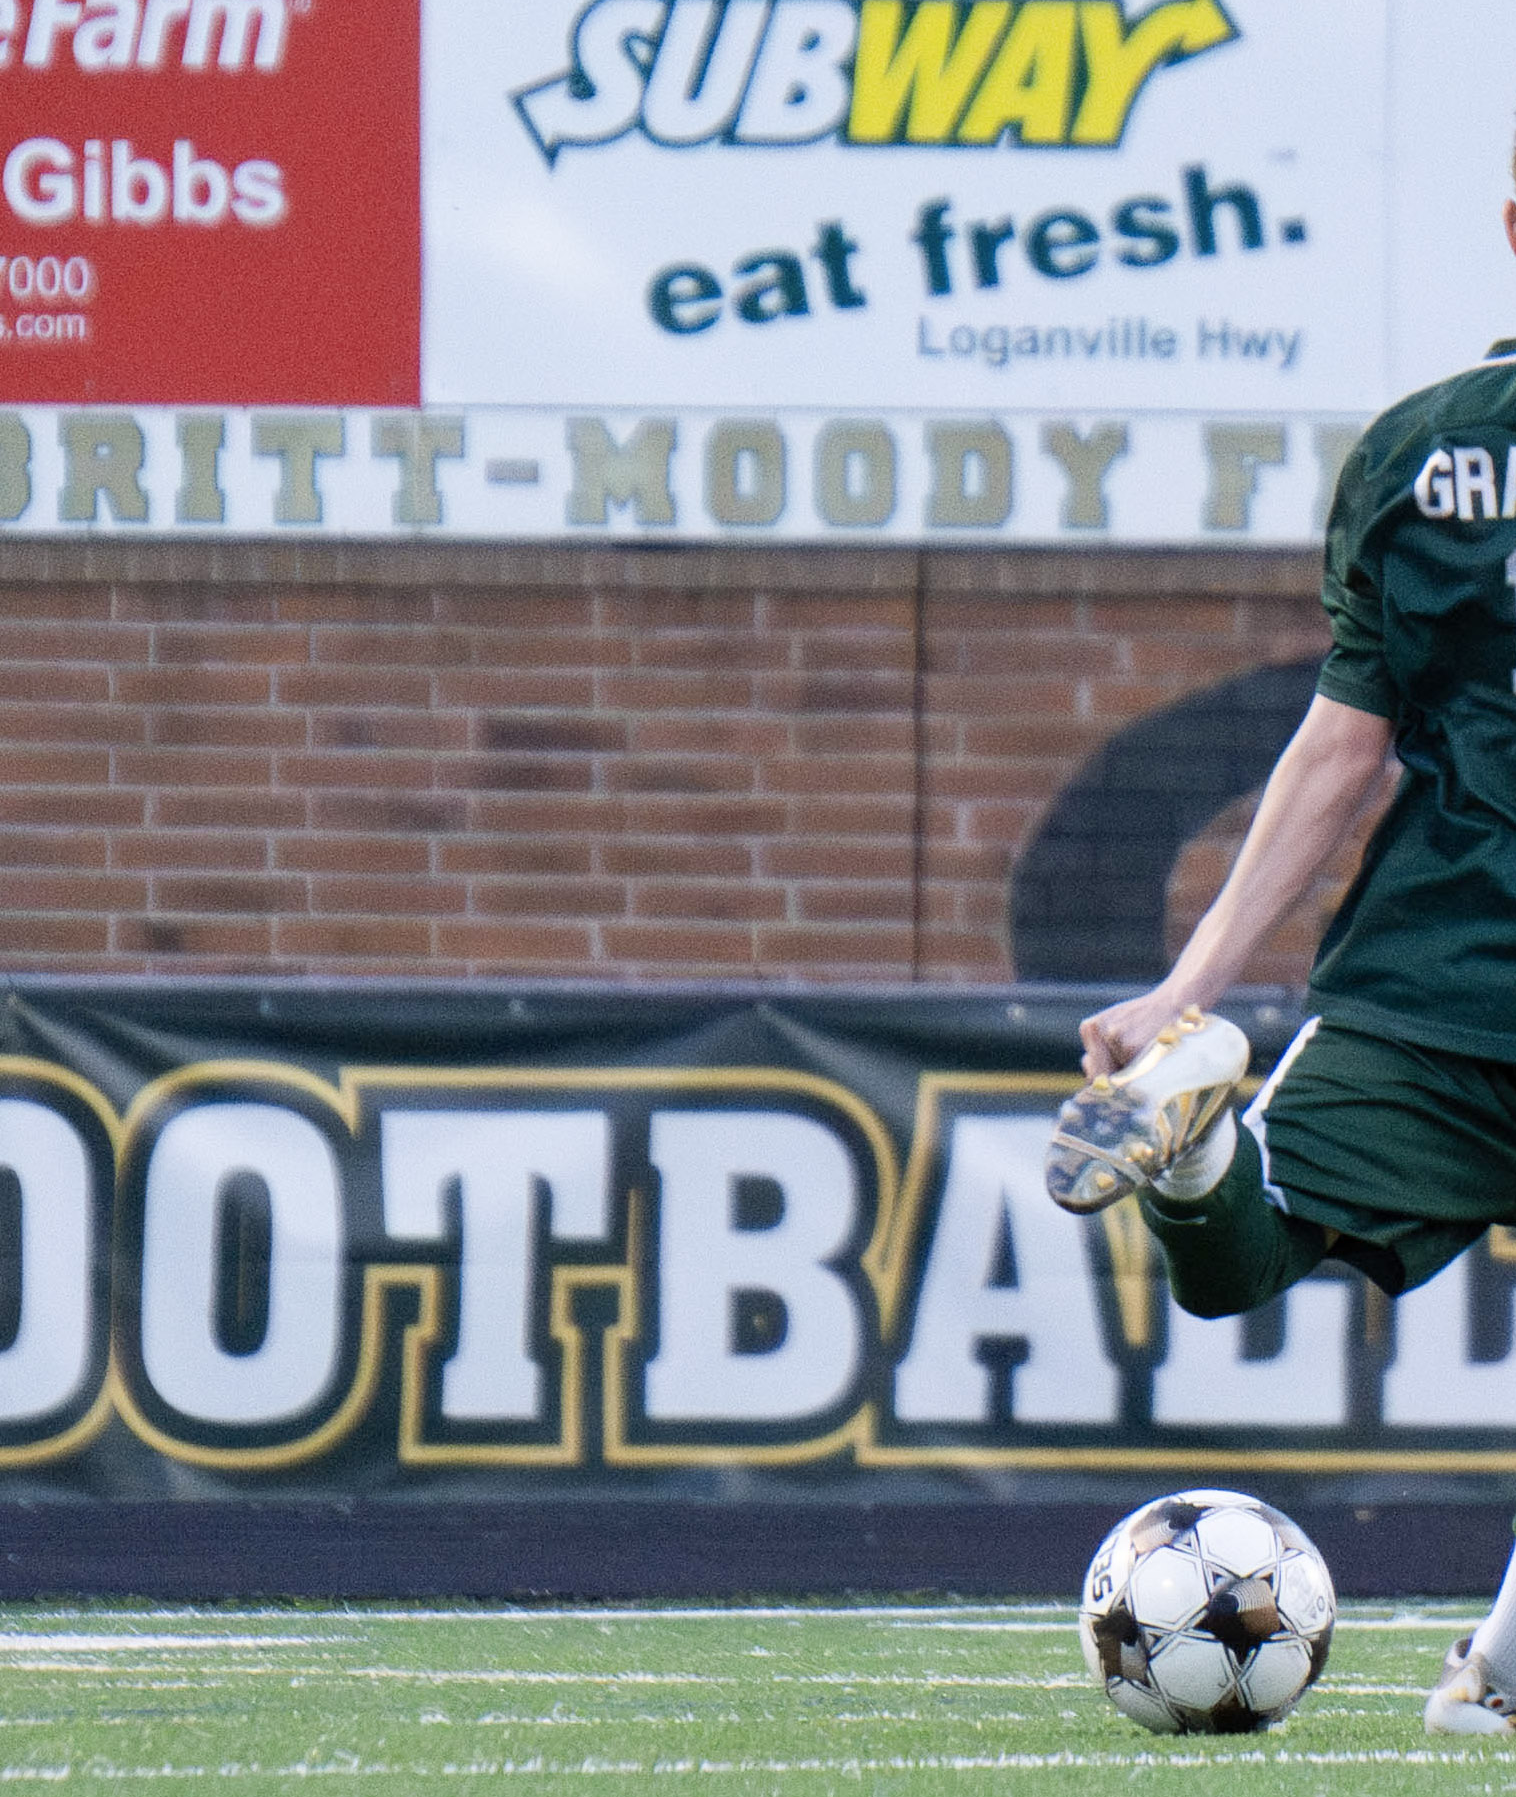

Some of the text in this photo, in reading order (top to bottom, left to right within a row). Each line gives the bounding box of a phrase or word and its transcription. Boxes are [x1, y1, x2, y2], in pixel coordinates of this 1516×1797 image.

[2, 135, 288, 229] Gibbs
[645, 161, 1308, 335] eat fresh.
[917, 315, 1304, 371] Loganville Hwy
